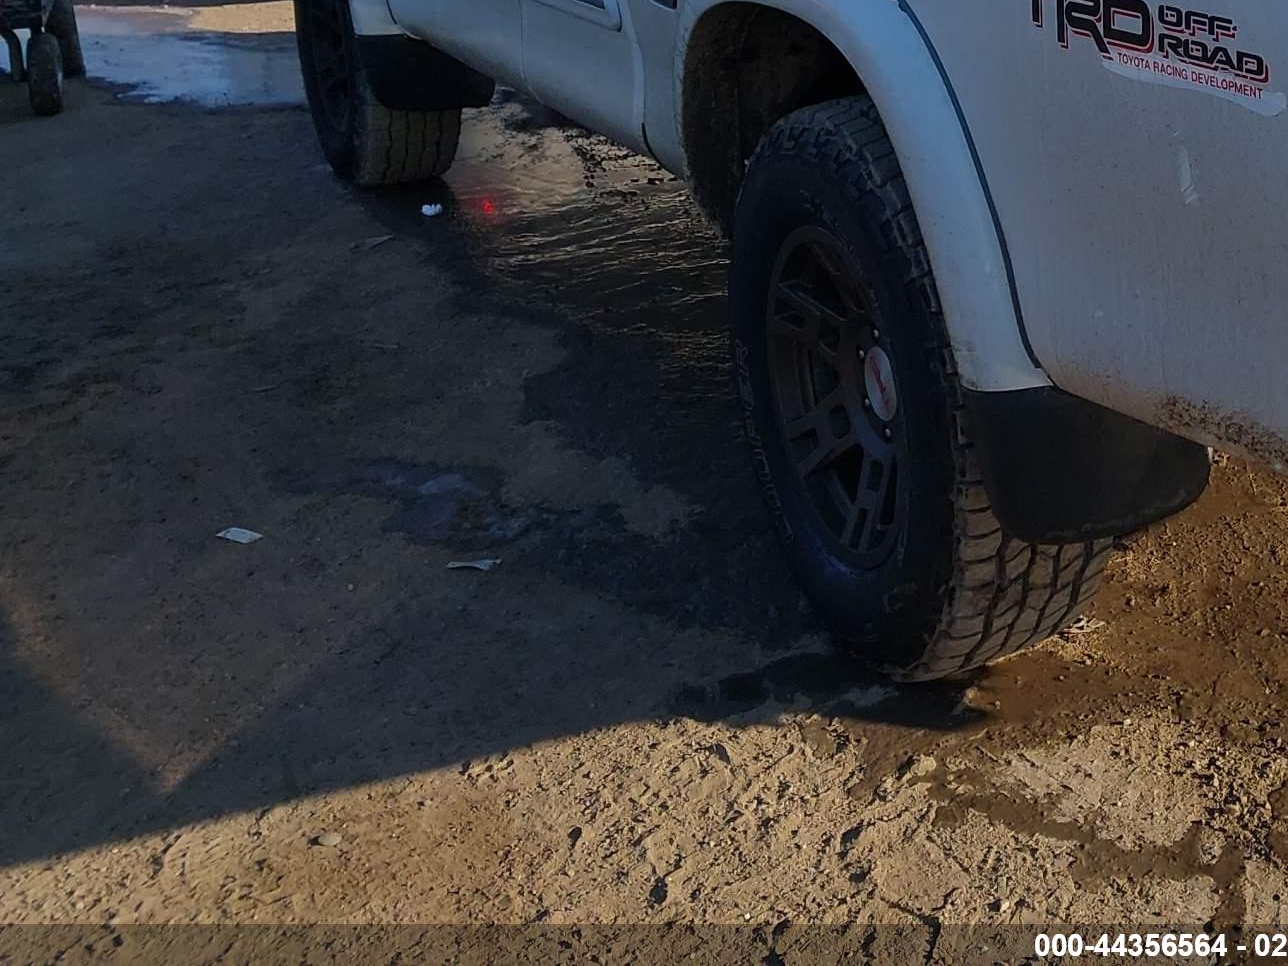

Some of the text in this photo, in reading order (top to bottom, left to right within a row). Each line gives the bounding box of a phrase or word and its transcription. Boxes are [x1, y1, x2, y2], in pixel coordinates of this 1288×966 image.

[1157, 4, 1236, 41] OFF
[1116, 51, 1263, 99] TOYOTA RACING DEVELOPMENT
[1158, 32, 1268, 82] ROAD
